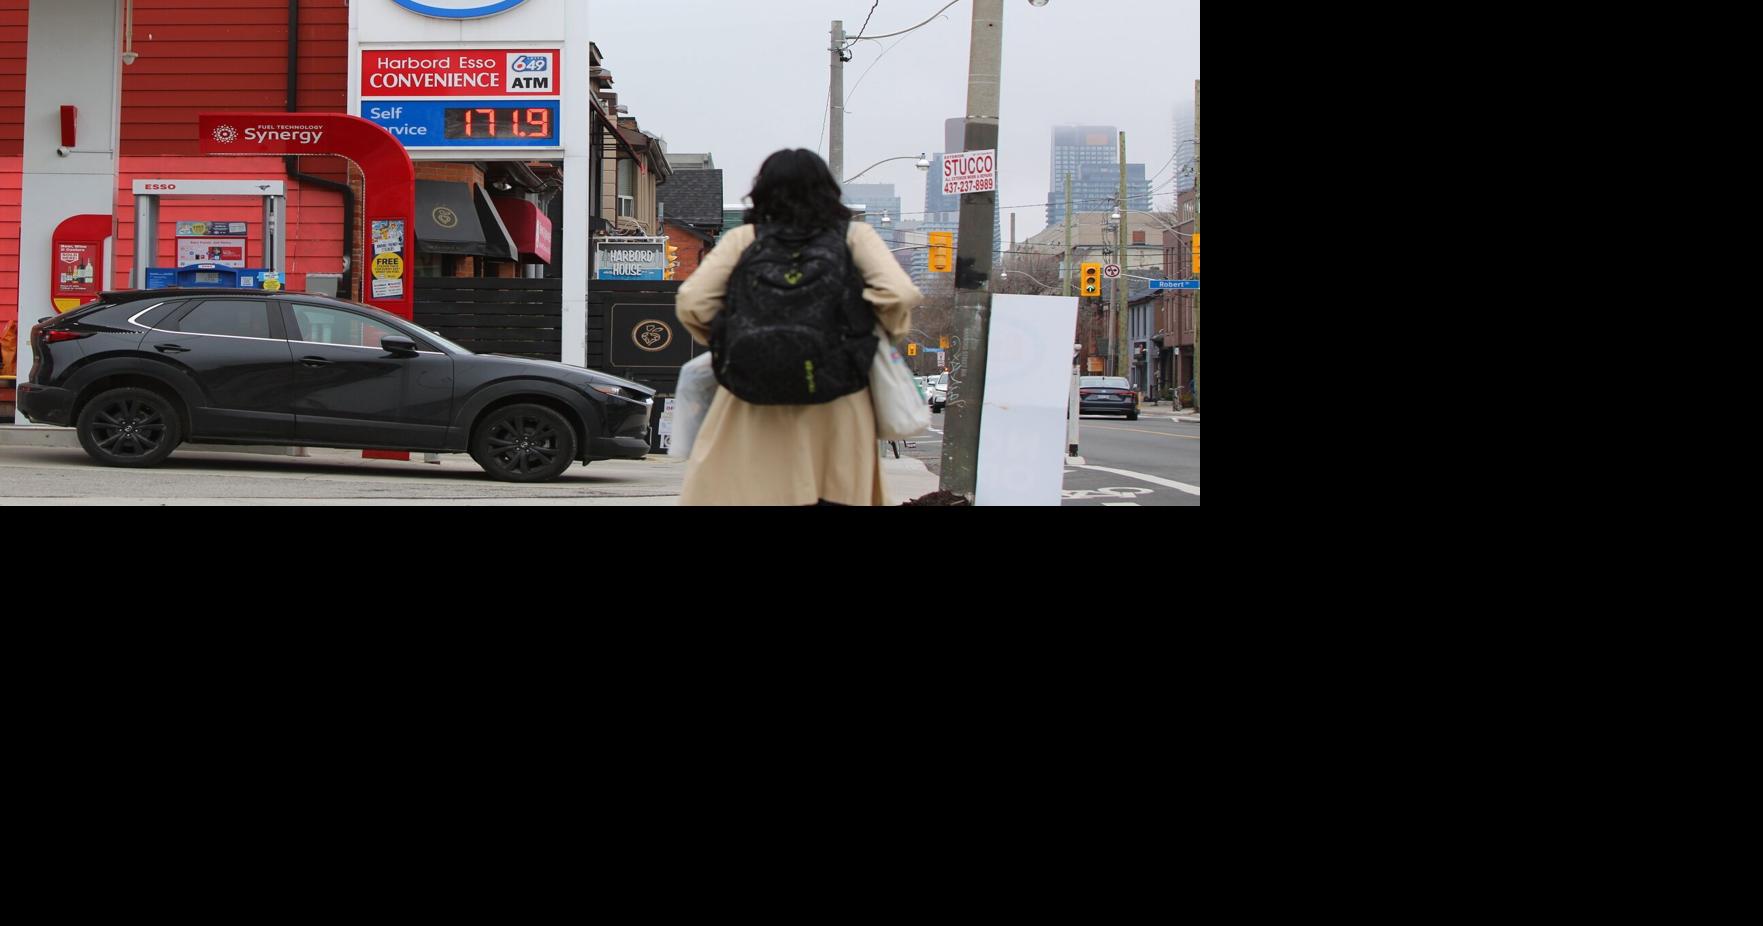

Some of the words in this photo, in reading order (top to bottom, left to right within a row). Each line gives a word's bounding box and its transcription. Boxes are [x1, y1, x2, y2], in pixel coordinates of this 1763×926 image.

[377, 56, 450, 69] Harbord
[459, 56, 496, 69] Esso
[369, 72, 499, 88] CONVENIENCE
[511, 77, 548, 89] ATM
[370, 107, 403, 119] Self
[383, 123, 427, 135] rvice
[464, 108, 548, 137] 171.9
[244, 127, 323, 144] Synergy
[944, 155, 993, 177] STUCCO
[944, 178, 993, 193] 437-237-8989
[610, 249, 653, 262] HARBORD
[613, 263, 642, 276] HOUSE
